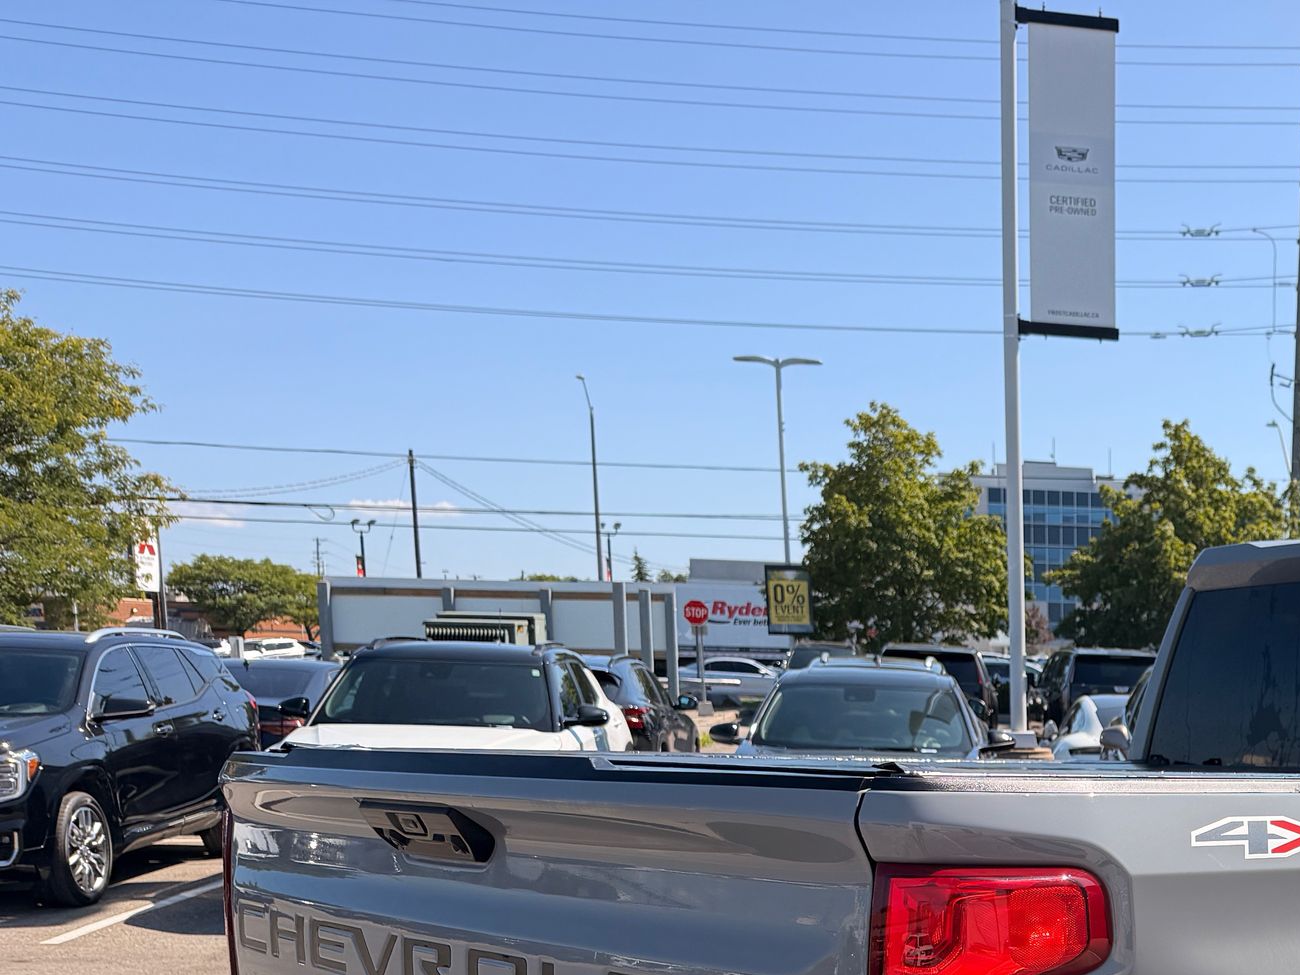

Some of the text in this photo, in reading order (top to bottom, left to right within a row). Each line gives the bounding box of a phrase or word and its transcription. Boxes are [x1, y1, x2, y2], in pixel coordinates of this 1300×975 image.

[1046, 164, 1099, 174] CADILLAC
[1050, 195, 1096, 207] CERTIFIED
[1049, 205, 1097, 216] PRE-OWNED
[773, 583, 805, 605] 0%
[686, 607, 707, 618] STOP
[775, 604, 804, 616] EVENT
[733, 617, 751, 625] Ever
